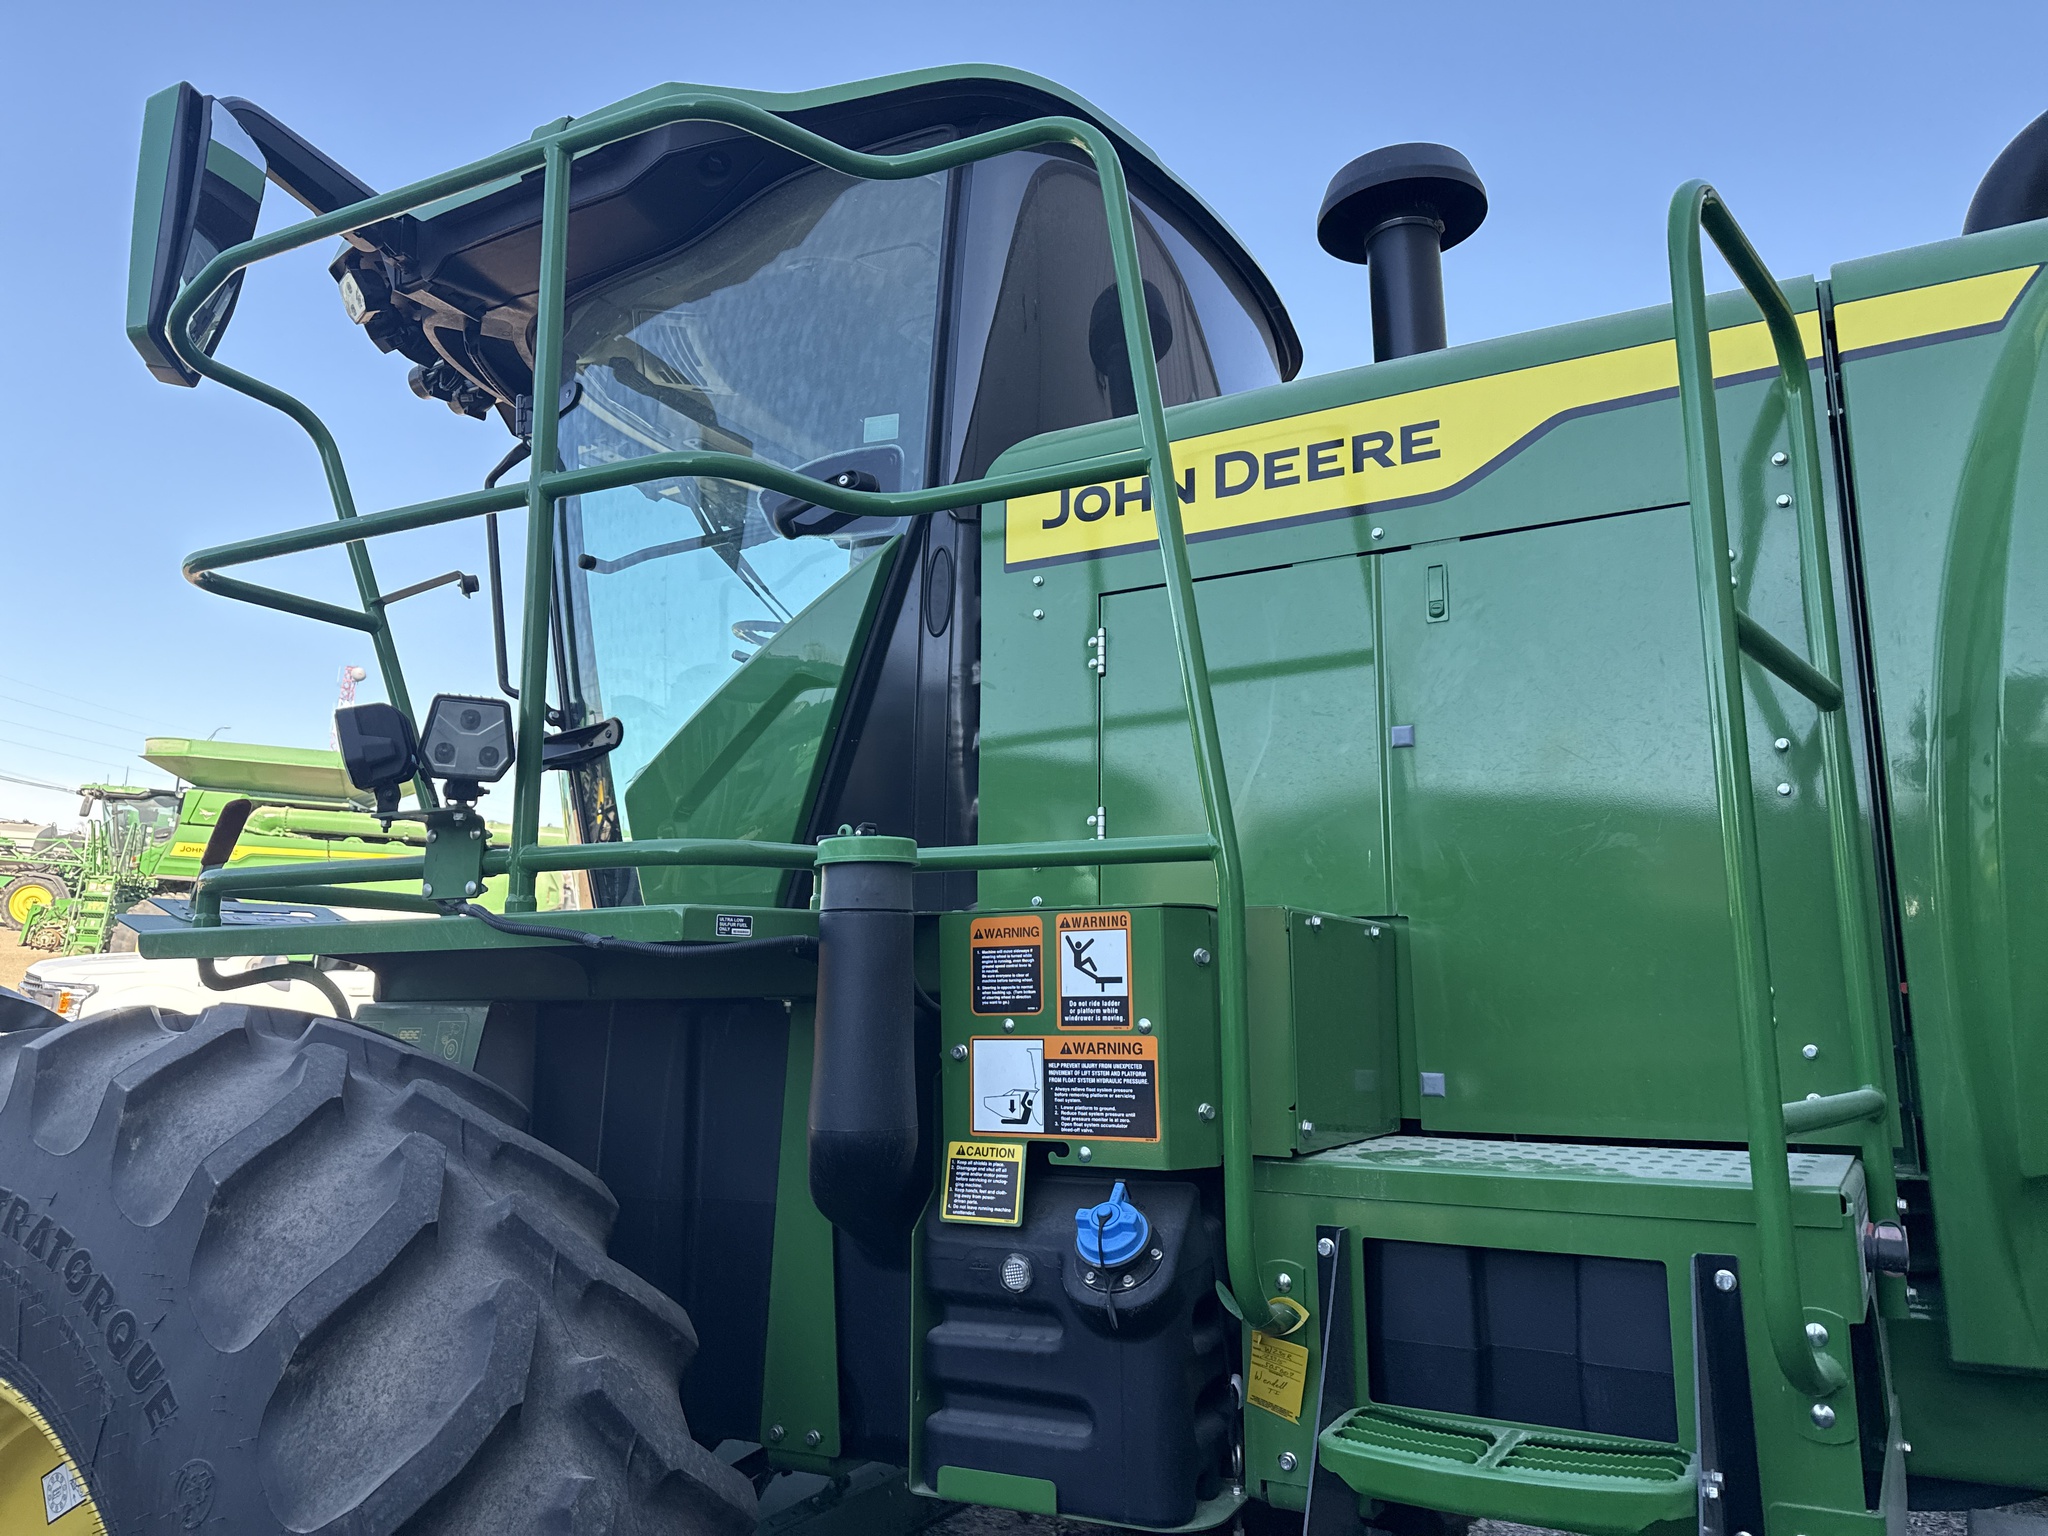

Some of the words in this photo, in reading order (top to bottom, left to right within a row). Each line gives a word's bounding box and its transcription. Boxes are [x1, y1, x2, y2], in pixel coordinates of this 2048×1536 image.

[1042, 467, 1195, 529] JOHN
[1215, 419, 1441, 499] DEERE
[1072, 915, 1127, 928] WARNING
[984, 926, 1040, 939] WARNING
[1073, 1042, 1142, 1055] WARNING
[967, 1146, 1015, 1158] CAUTION
